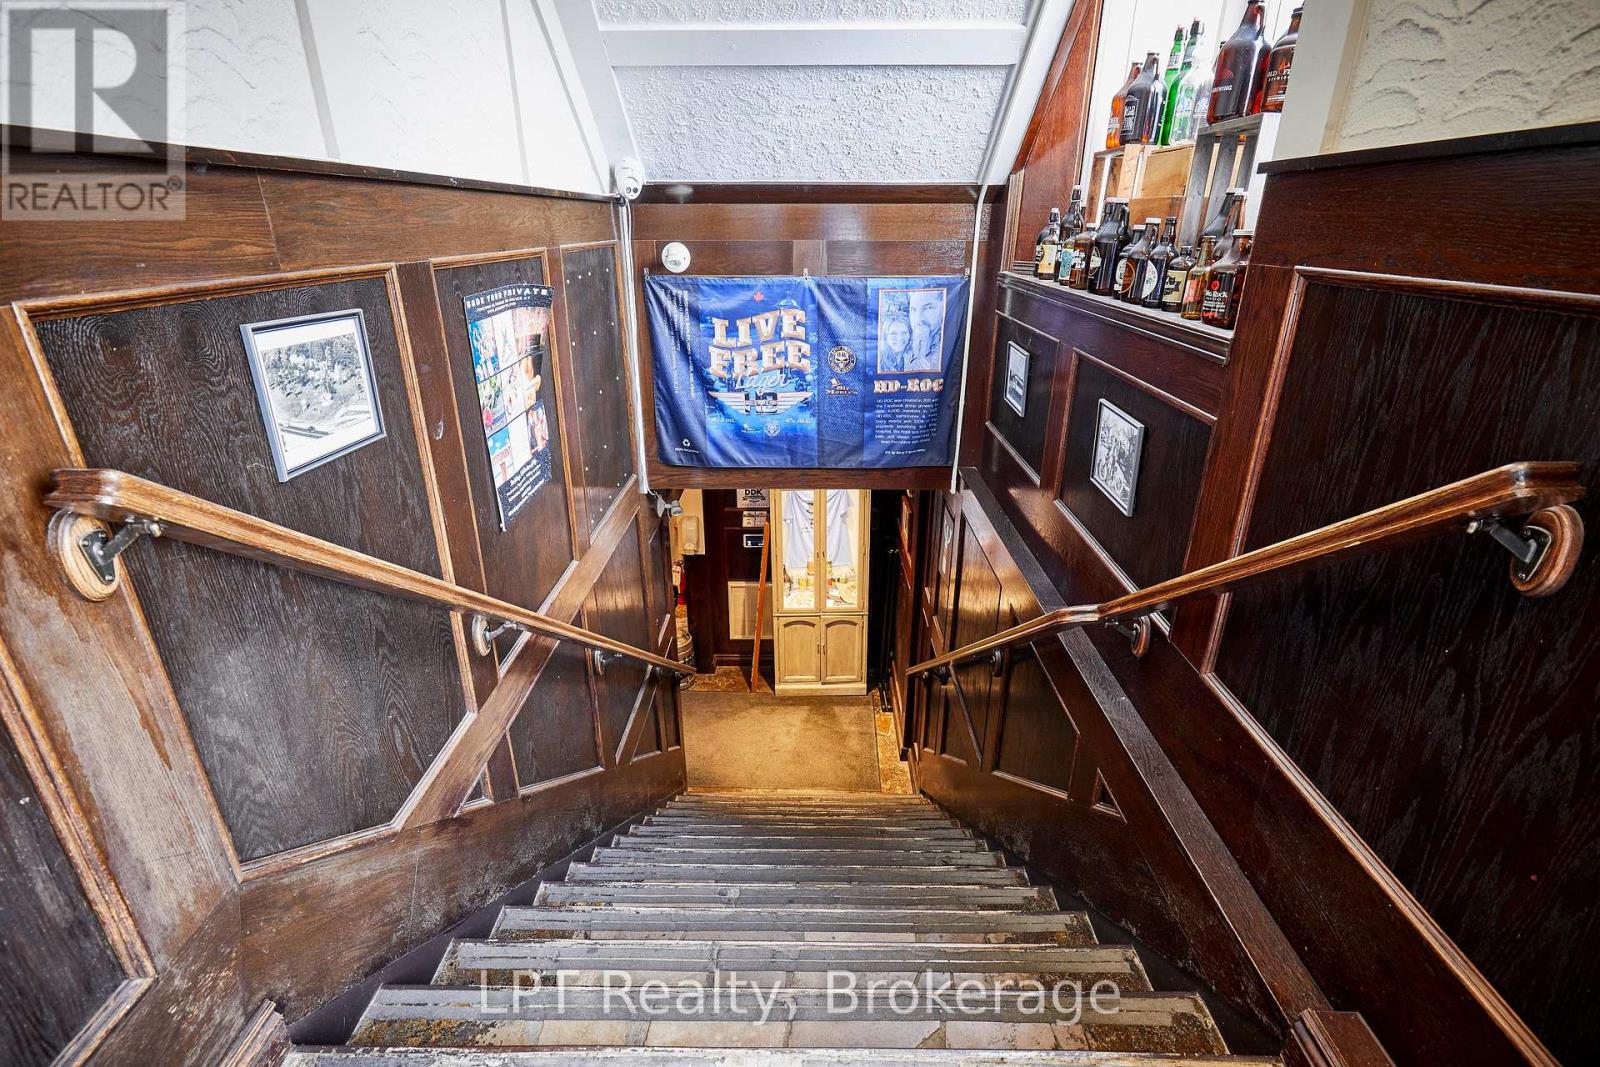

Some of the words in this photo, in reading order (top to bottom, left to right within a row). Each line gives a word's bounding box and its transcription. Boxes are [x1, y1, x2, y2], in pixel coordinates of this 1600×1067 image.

[503, 287, 548, 298] PRIVATE
[711, 308, 806, 348] LIVE
[708, 340, 811, 379] FREE
[734, 370, 797, 396] Lager
[873, 378, 944, 393] HD-ROC
